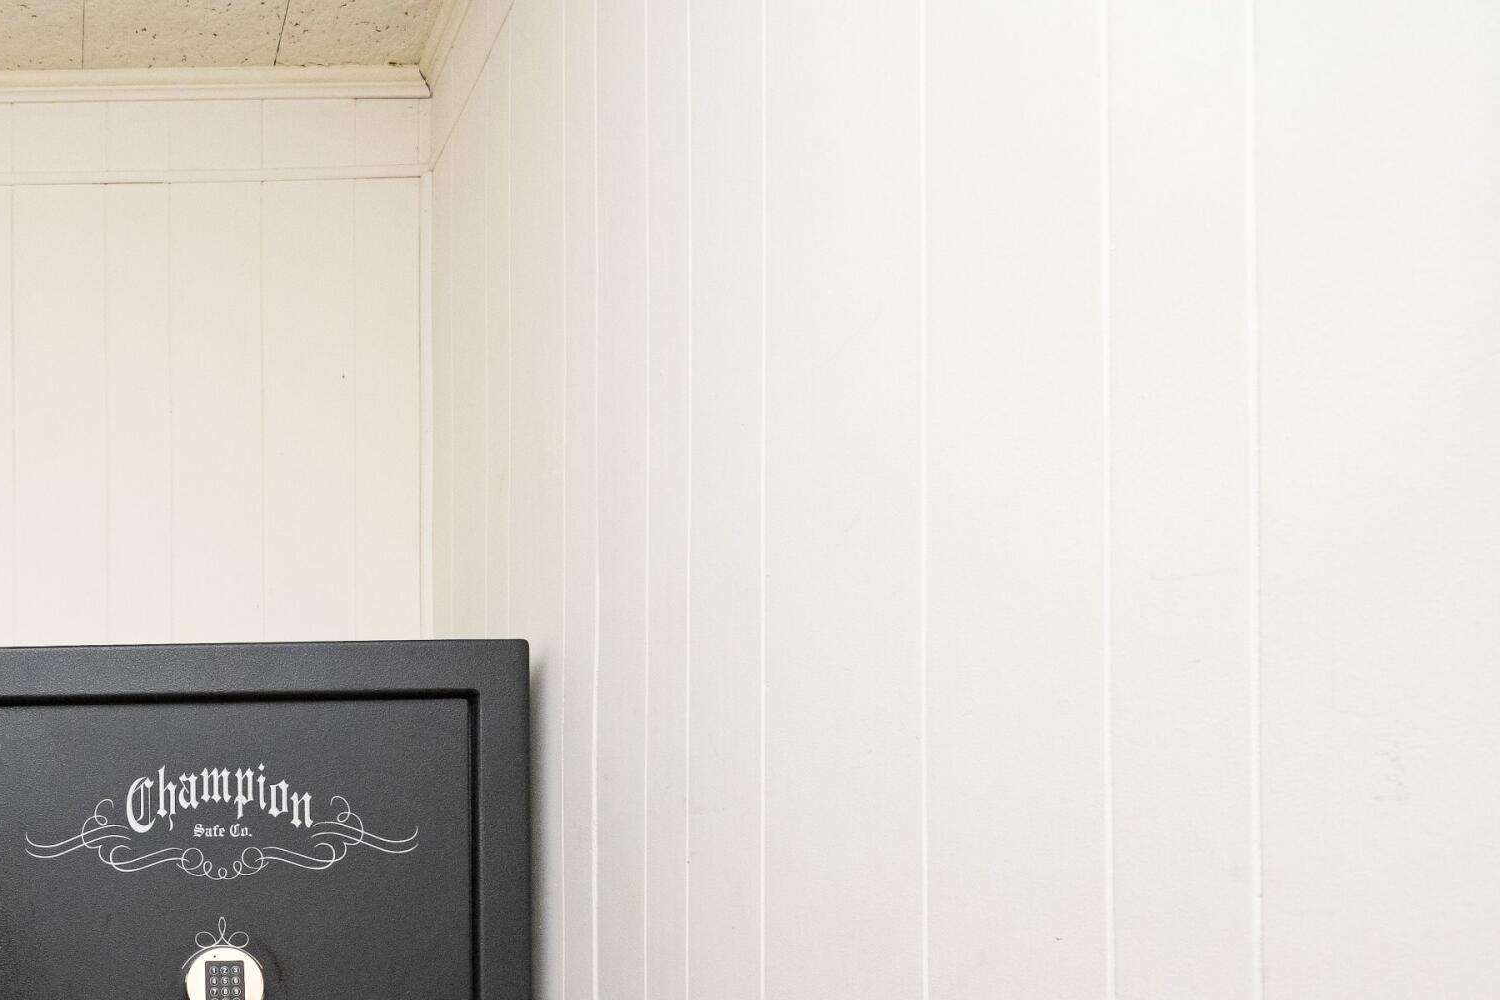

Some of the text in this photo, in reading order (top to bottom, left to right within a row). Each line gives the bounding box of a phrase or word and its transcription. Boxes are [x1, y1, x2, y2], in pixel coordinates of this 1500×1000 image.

[126, 762, 314, 833] Champion
[193, 823, 253, 838] Safe Co.
